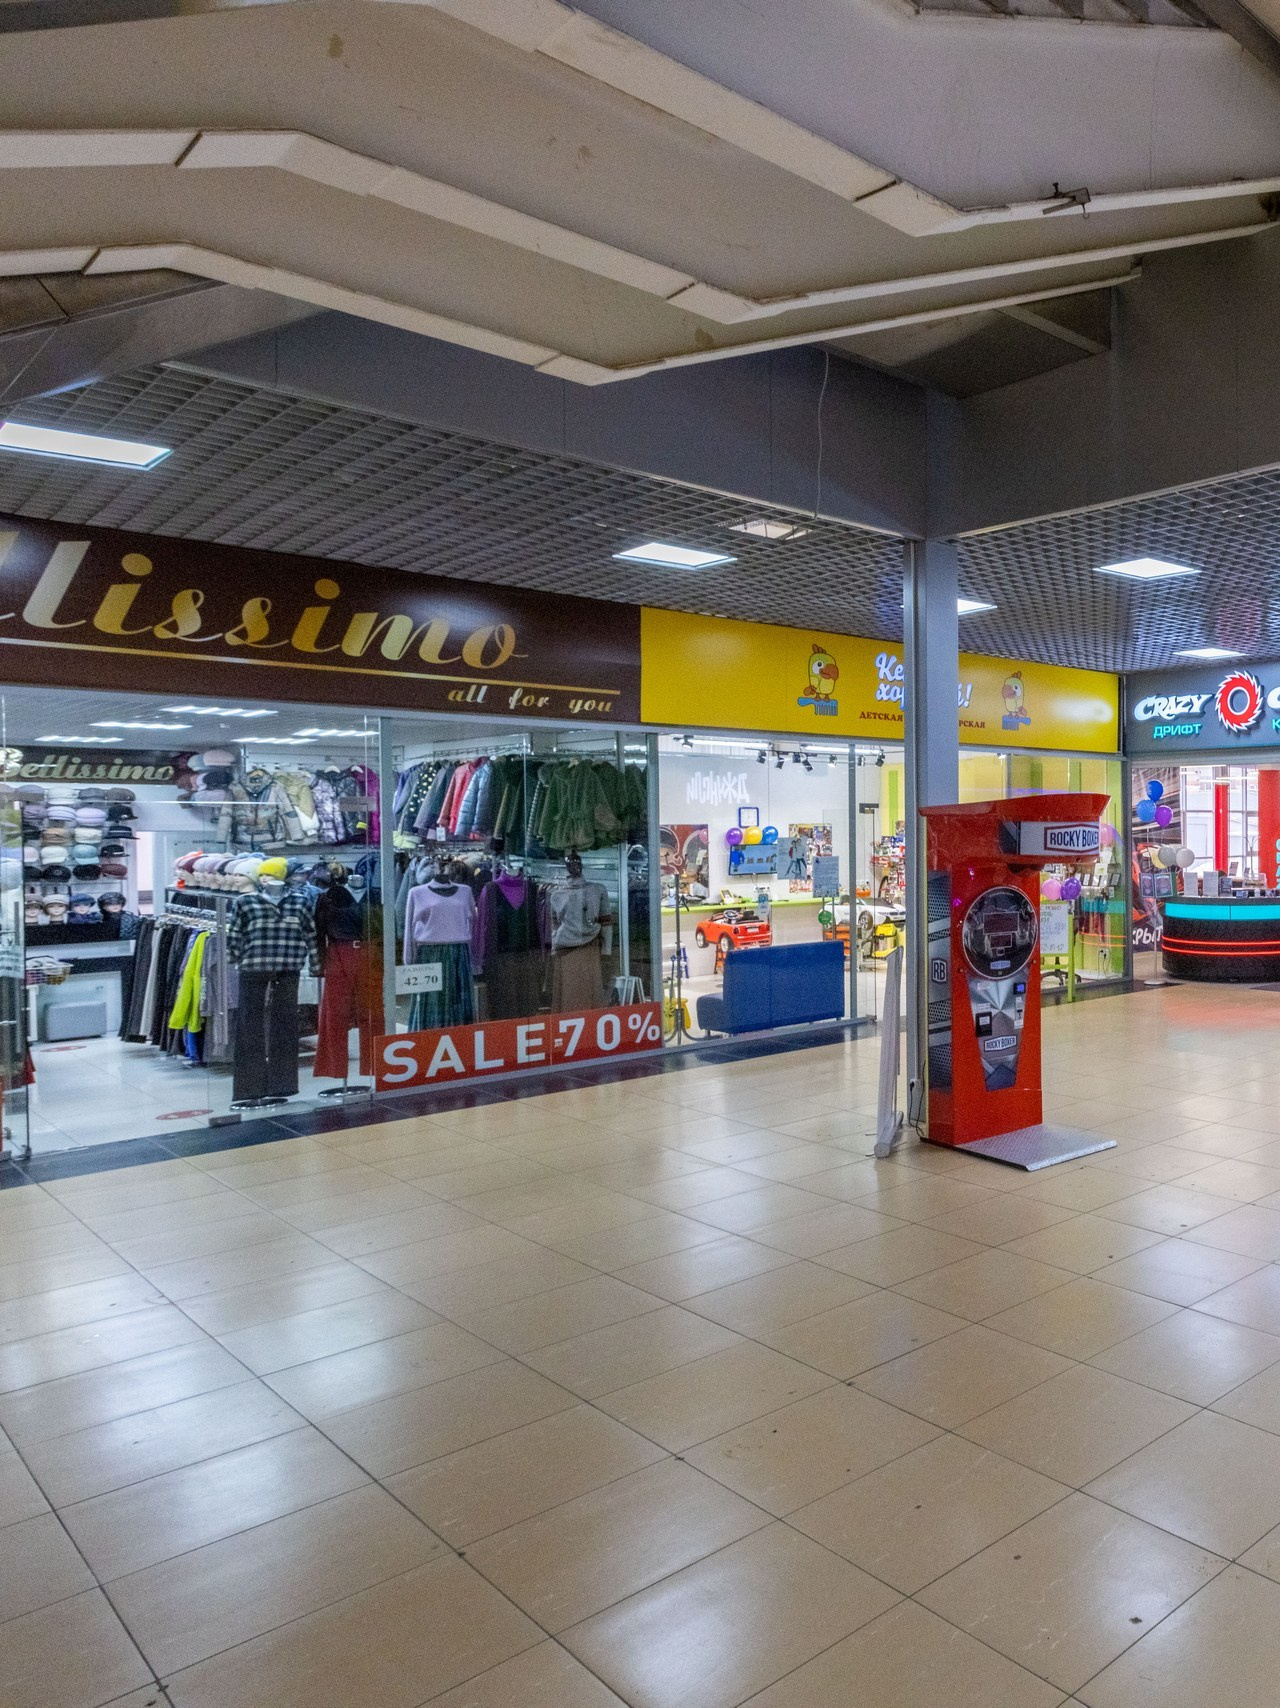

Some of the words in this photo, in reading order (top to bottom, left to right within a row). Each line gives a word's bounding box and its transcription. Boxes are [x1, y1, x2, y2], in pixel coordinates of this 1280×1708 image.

[447, 684, 489, 704] all
[508, 688, 550, 710] for
[568, 698, 613, 714] you
[1134, 693, 1213, 721] CRAZY
[859, 711, 904, 722] ДЕТСКАЯ
[1153, 723, 1202, 739] ДРИФТ
[1050, 830, 1081, 847] ROCKY
[933, 961, 947, 980] RB
[382, 1022, 546, 1083] SALE
[986, 1041, 1000, 1050] ROCKY
[1001, 1037, 1015, 1048] BOXER
